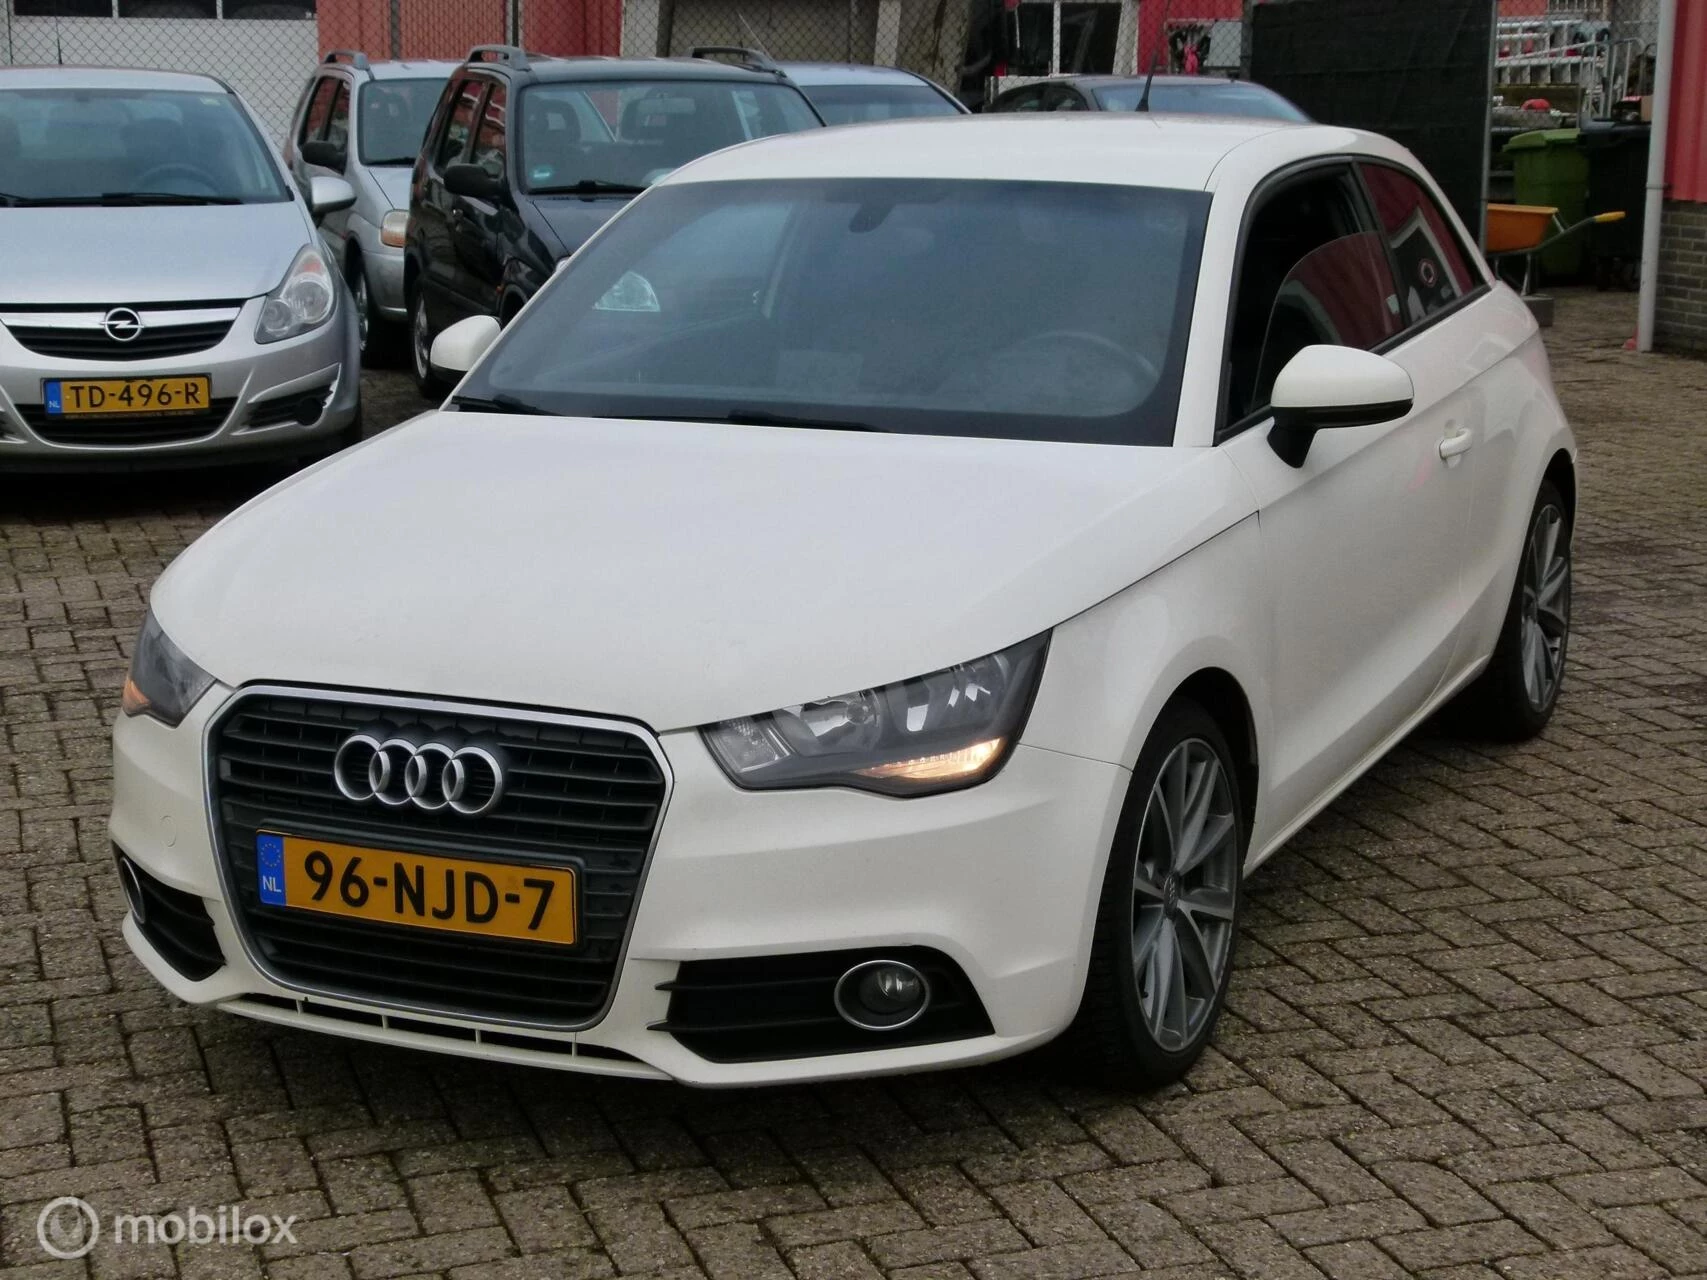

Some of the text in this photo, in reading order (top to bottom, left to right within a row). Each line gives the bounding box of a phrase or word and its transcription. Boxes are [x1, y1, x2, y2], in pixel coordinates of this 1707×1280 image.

[48, 382, 200, 408] NL TD-496-R
[262, 851, 555, 930] NL 96-NJD-7
